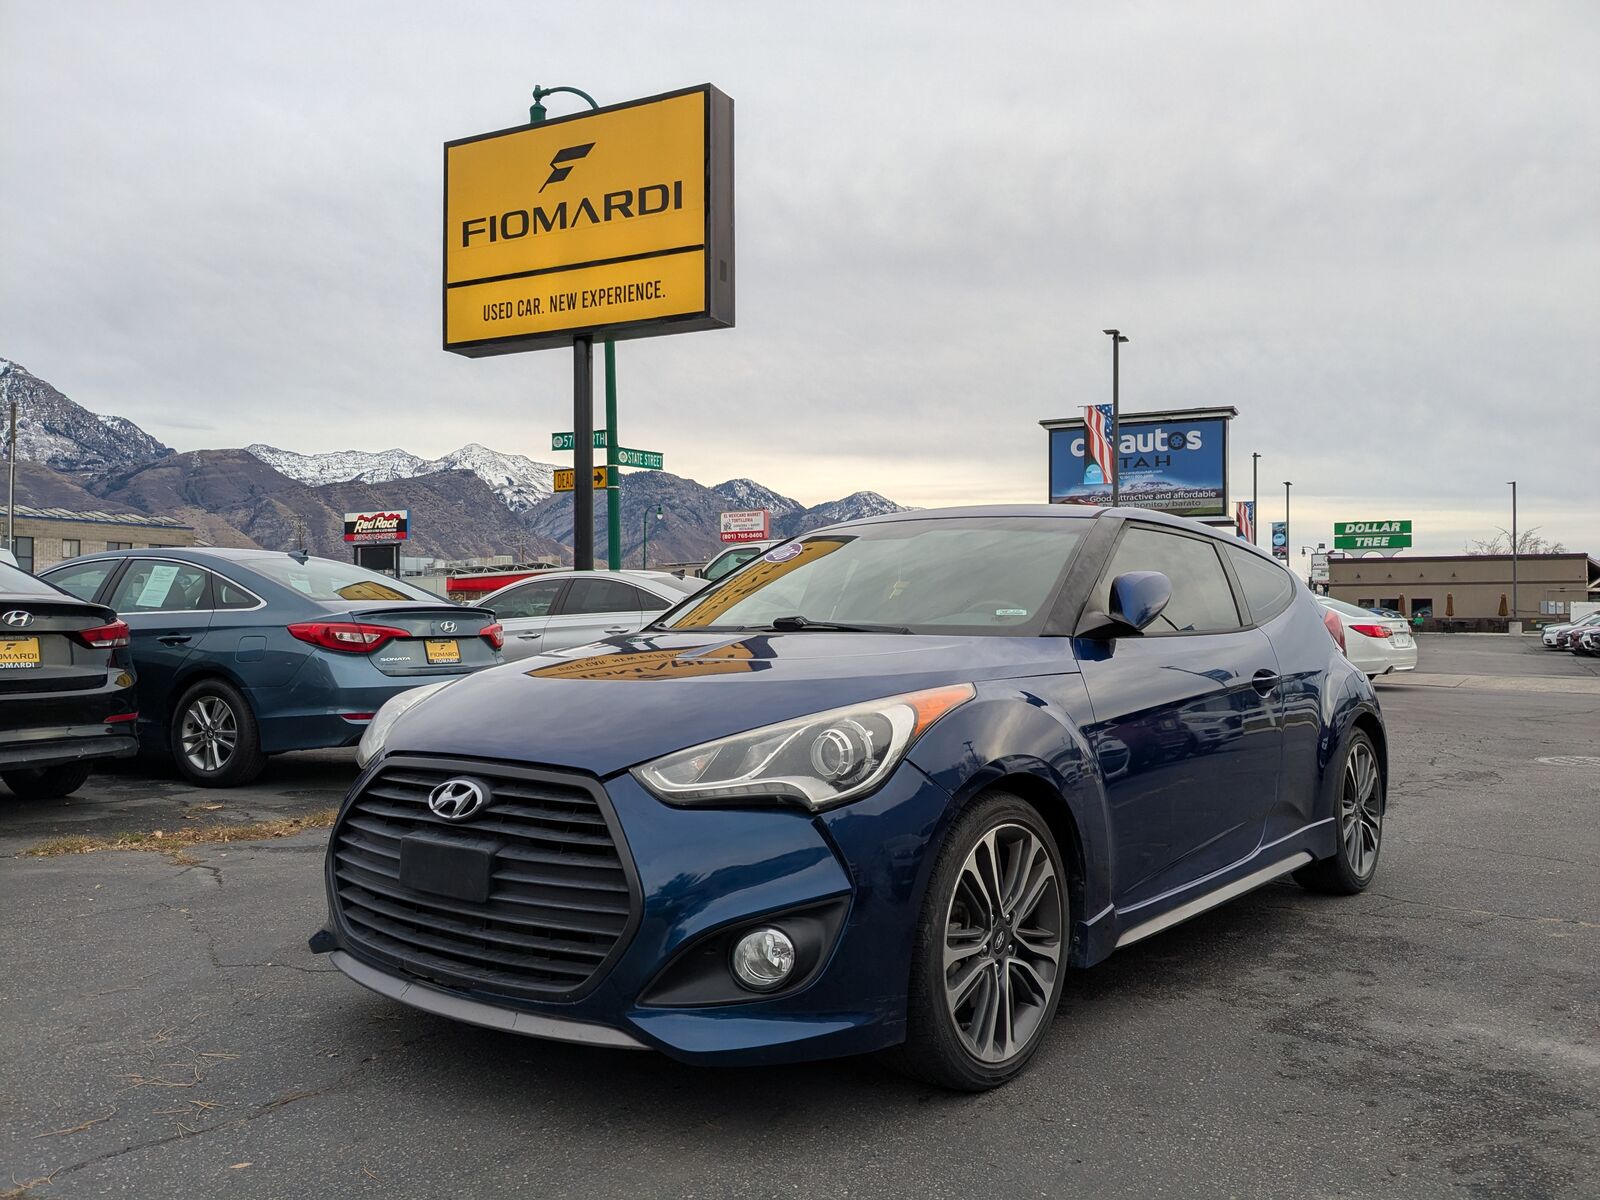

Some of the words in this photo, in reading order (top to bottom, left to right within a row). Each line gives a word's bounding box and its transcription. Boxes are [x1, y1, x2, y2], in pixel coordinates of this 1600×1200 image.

[462, 180, 683, 247] FIOMARDI
[483, 301, 513, 321] USED
[517, 297, 545, 317] CAR.
[549, 291, 577, 313] NEW
[582, 280, 666, 308] EXPERIENCE.
[628, 451, 643, 465] STATE
[644, 453, 662, 467] STREET
[1118, 455, 1171, 469] TAH
[1118, 492, 1154, 502] ttractive
[1155, 491, 1172, 500] and
[1173, 489, 1217, 499] affordable
[1172, 499, 1201, 507] barato
[353, 519, 376, 533] Red
[374, 516, 399, 529] Rock
[1344, 522, 1401, 534] DOLLAR
[1355, 536, 1391, 547] TREE
